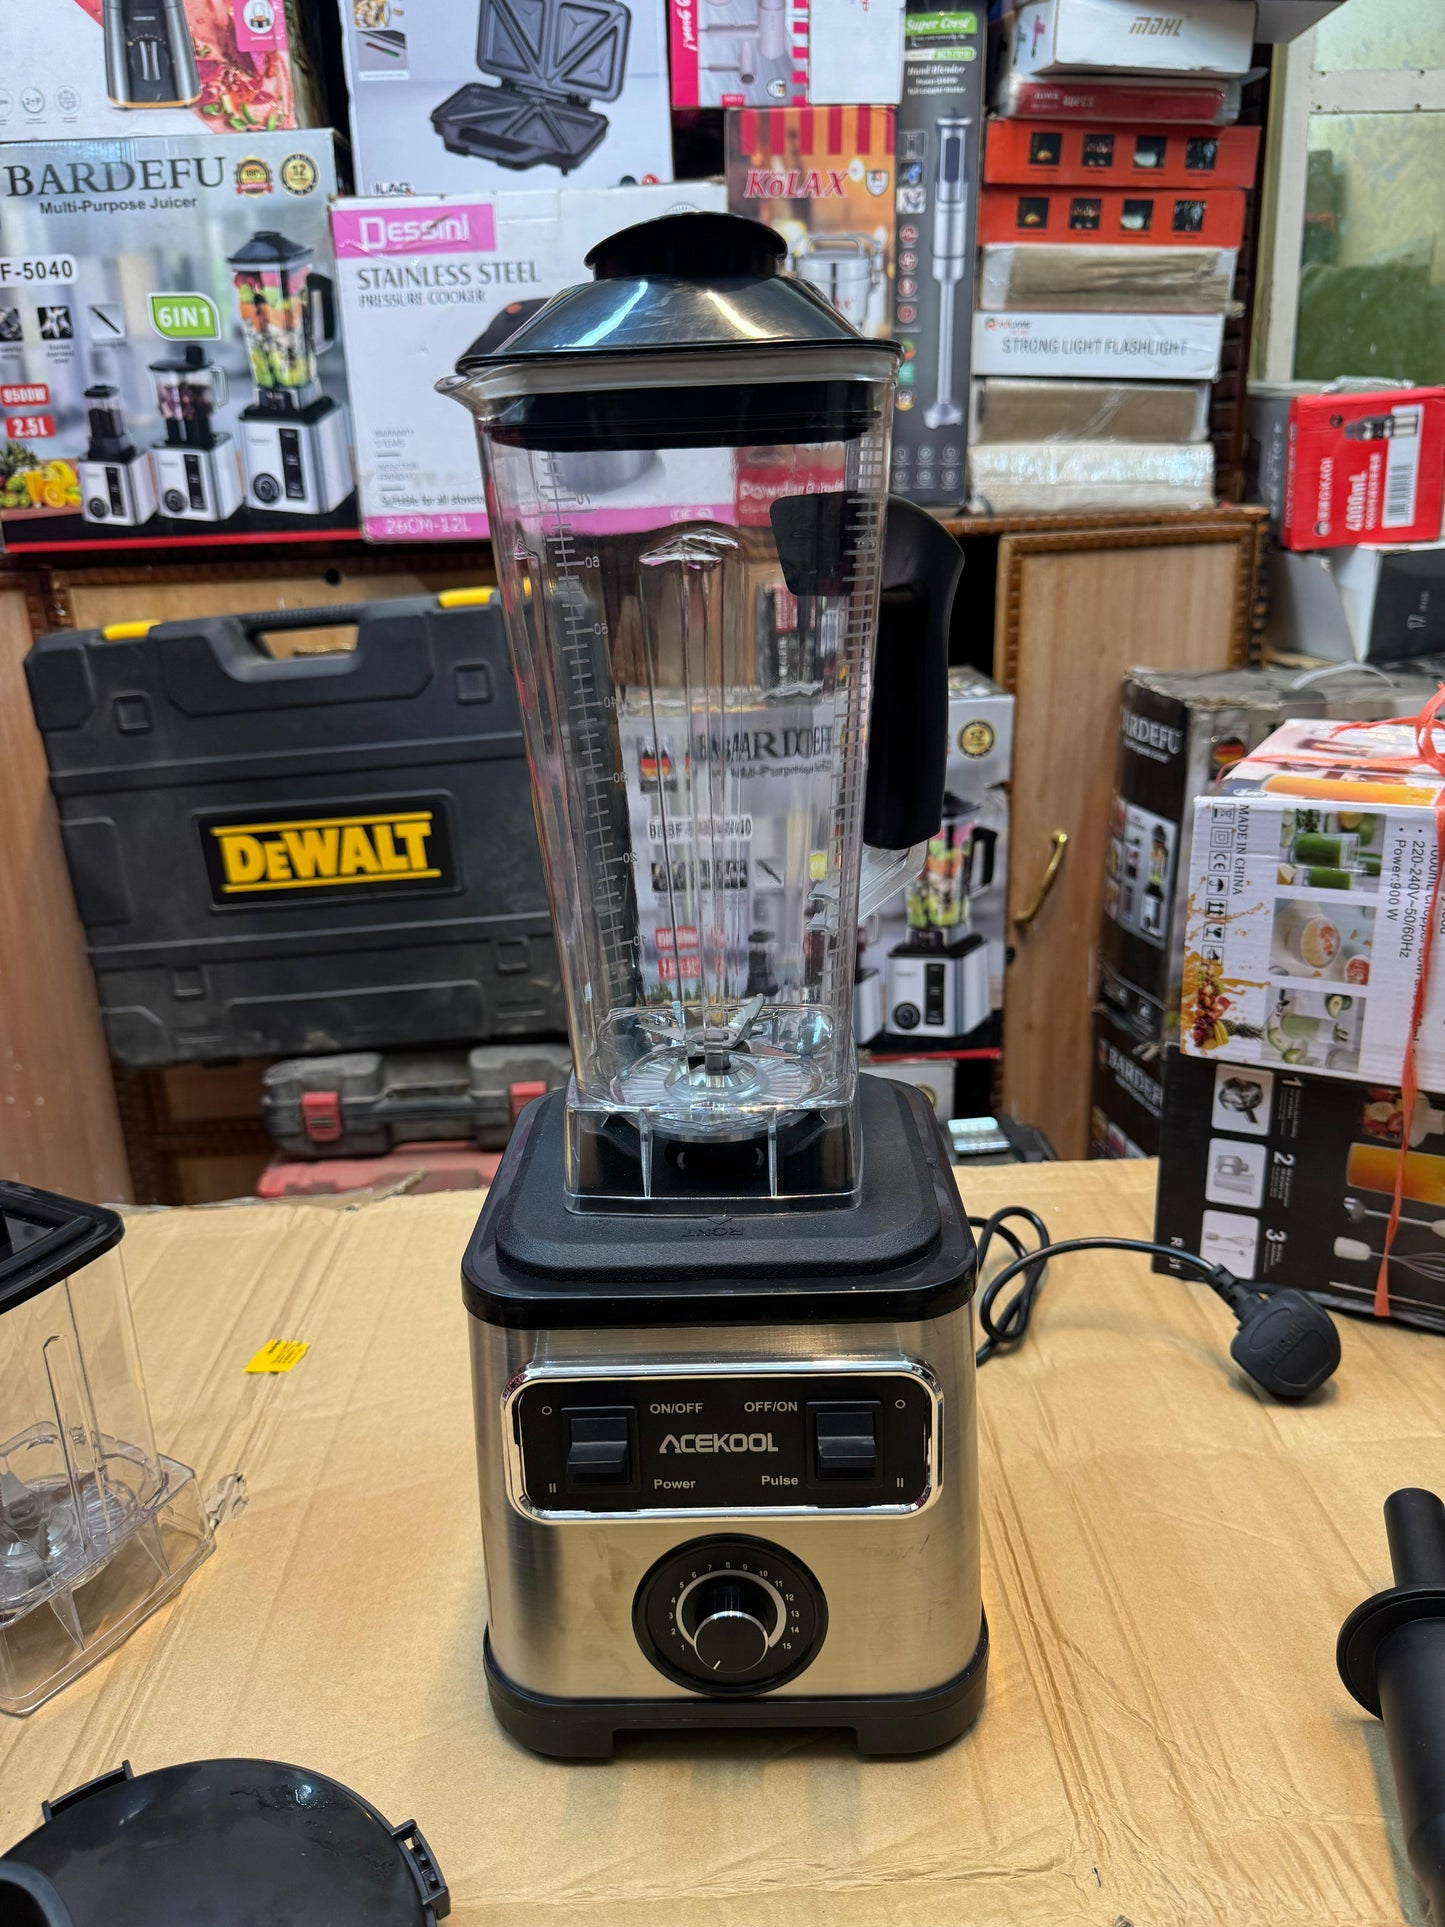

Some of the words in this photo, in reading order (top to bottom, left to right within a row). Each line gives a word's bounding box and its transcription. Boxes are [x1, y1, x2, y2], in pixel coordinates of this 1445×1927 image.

[4, 157, 227, 197] BARDEFU
[40, 200, 147, 216] Multi-Purpose
[151, 197, 198, 210] Juicer
[1, 260, 74, 282] F-5040
[357, 265, 472, 290] STAINLESS
[479, 261, 541, 285] STEEL
[359, 290, 424, 308] PRESSURE
[427, 288, 487, 306] COOKER
[1001, 336, 1058, 355] STRONG
[1062, 337, 1102, 355] LIGHT
[1104, 338, 1190, 356] FLASHLIGHT
[12, 416, 48, 437] 2.5L
[1236, 804, 1250, 840] MADE
[1235, 842, 1247, 855] IN
[1232, 857, 1246, 895] CHINA
[1386, 908, 1400, 922] W
[1273, 1150, 1296, 1168] 2
[1264, 1227, 1288, 1243] 3
[649, 1402, 704, 1415] ON/OFF
[743, 1400, 799, 1413] OFF/ON
[659, 1432, 780, 1454] ACEKOOL
[653, 1478, 697, 1490] Power
[761, 1475, 800, 1486] Pulse
[725, 1561, 731, 1569] 8
[742, 1563, 748, 1571] 9
[691, 1571, 697, 1579] 6
[679, 1581, 685, 1589] 5
[774, 1580, 783, 1588] 11
[670, 1596, 676, 1604] 4
[785, 1593, 795, 1601] 12
[668, 1612, 674, 1620] 3
[790, 1610, 800, 1618] 13
[671, 1628, 677, 1636] 2
[790, 1626, 800, 1634] 14
[680, 1643, 686, 1651] 1
[782, 1642, 792, 1650] 15
